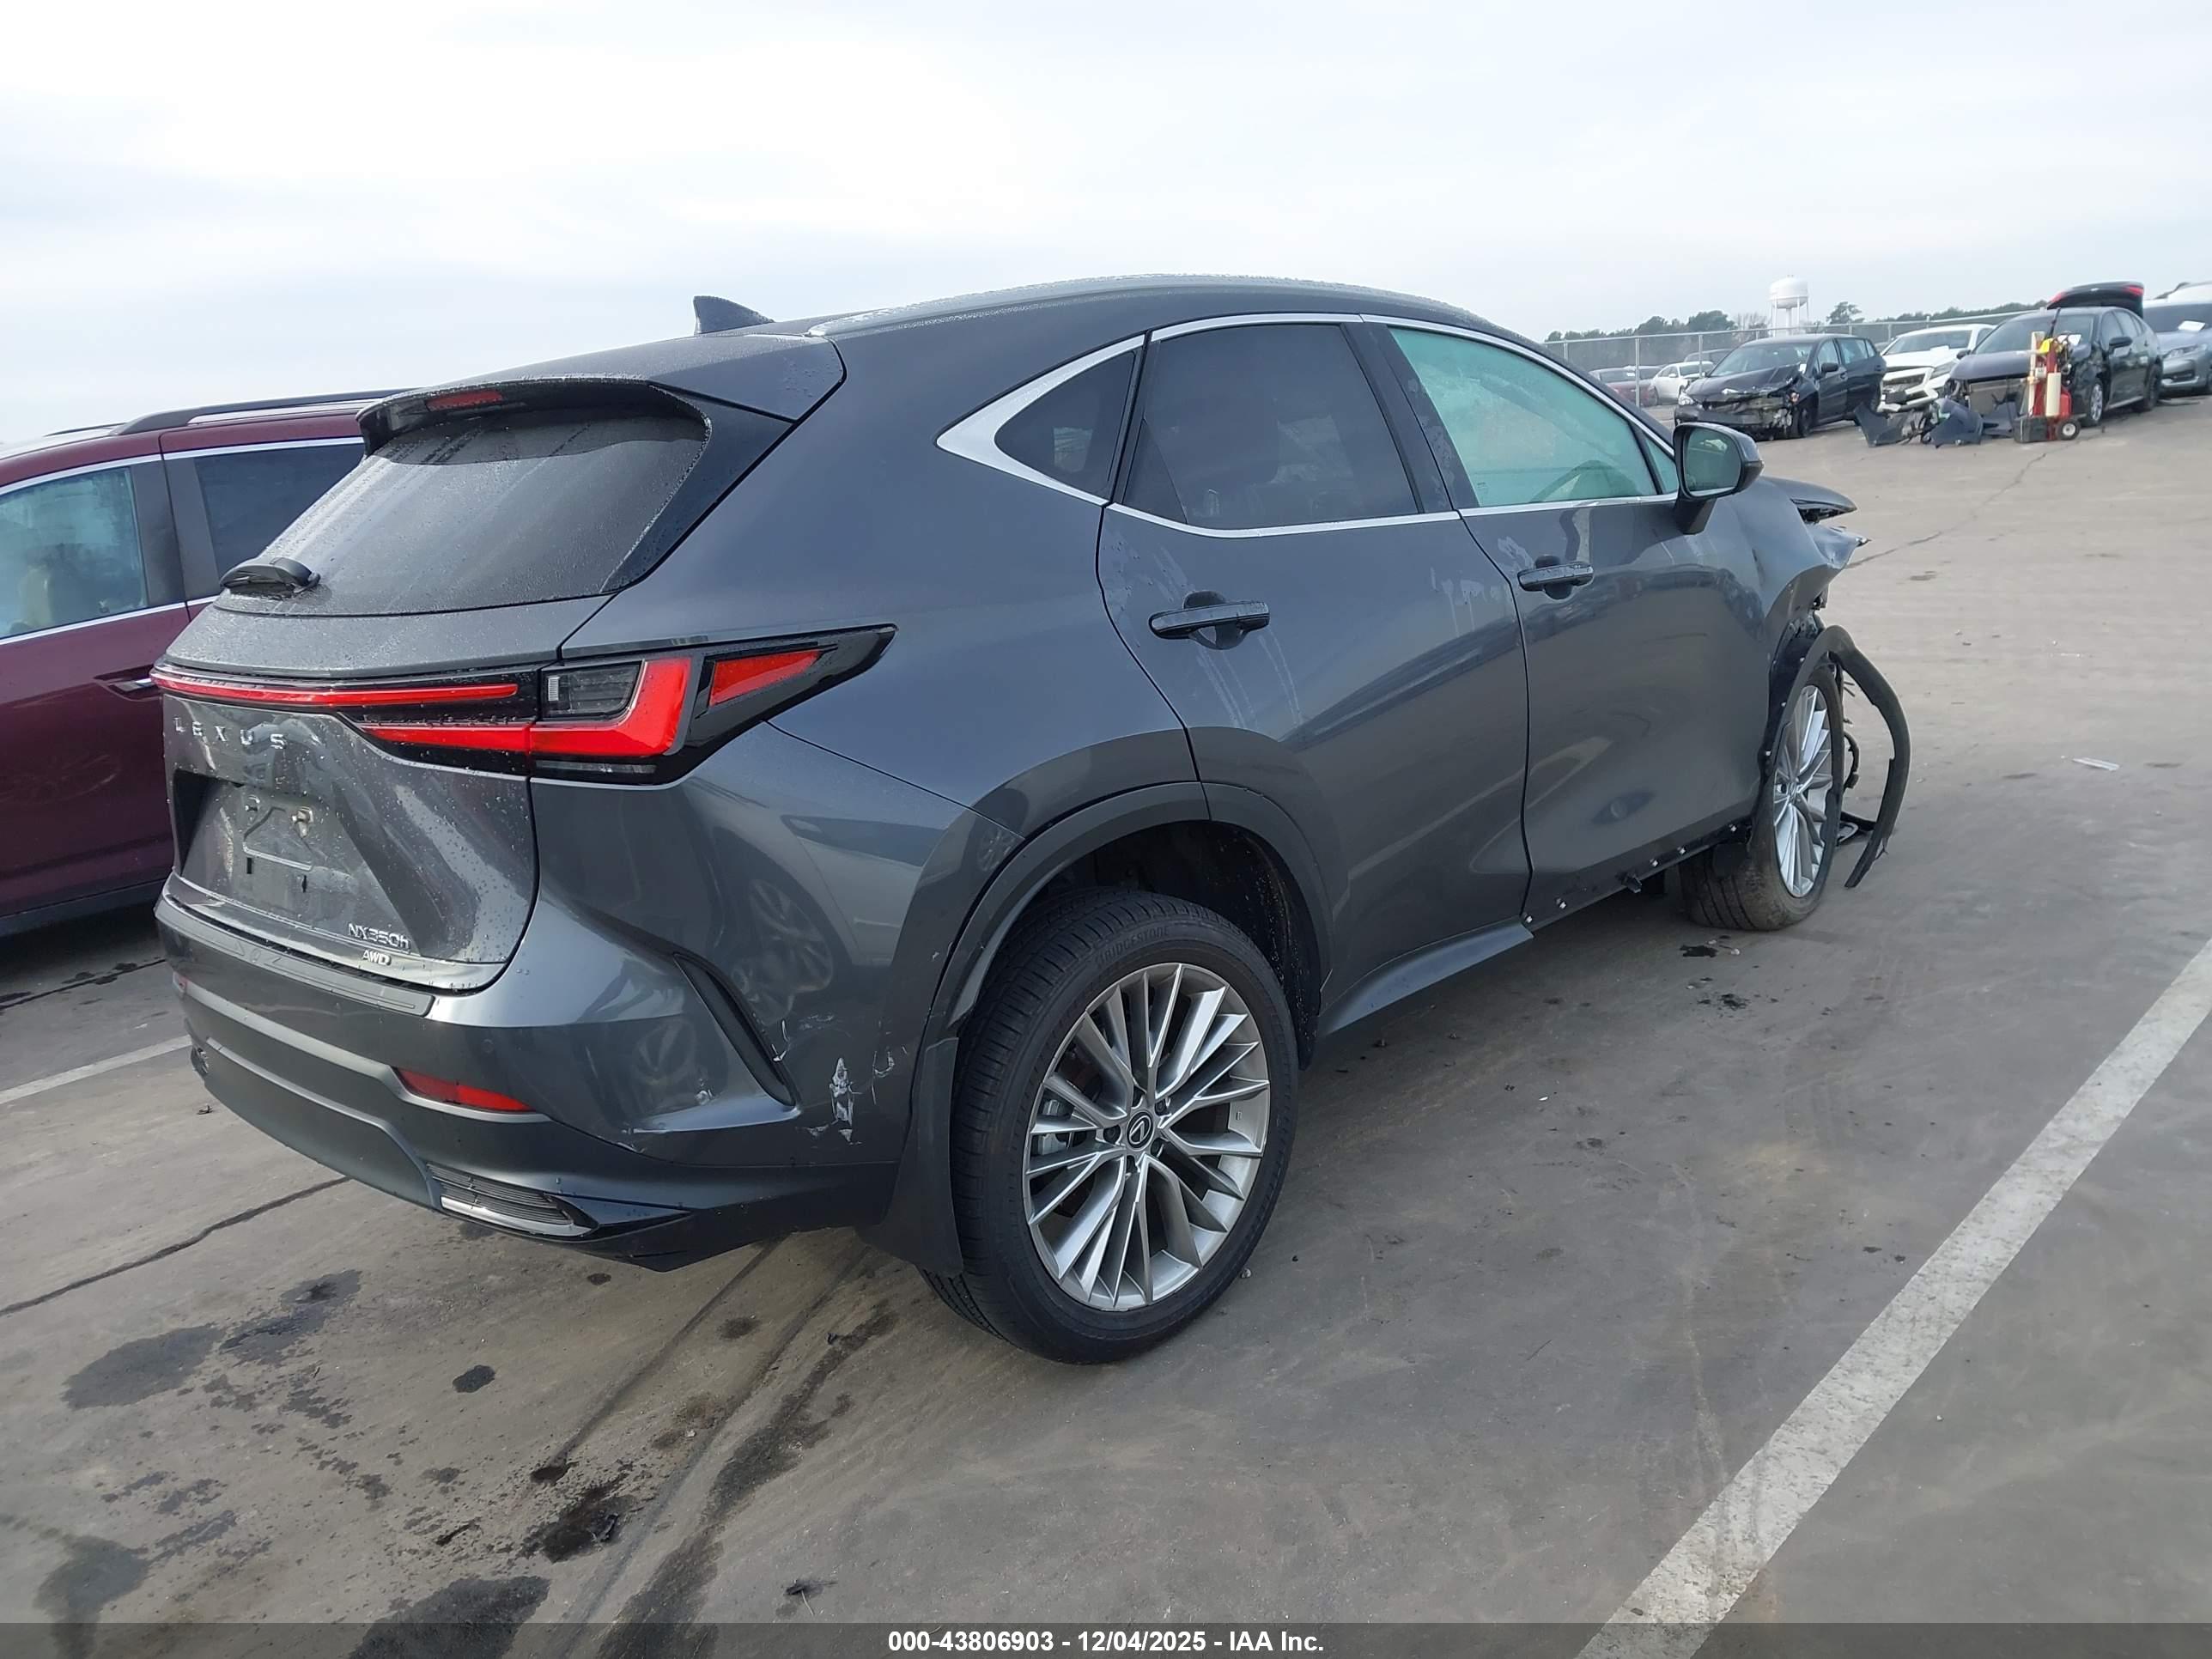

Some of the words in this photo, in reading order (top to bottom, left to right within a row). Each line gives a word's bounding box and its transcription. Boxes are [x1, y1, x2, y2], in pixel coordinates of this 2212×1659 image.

[173, 715, 286, 750] LEXUS
[349, 923, 410, 950] NX350h
[362, 950, 391, 966] AWD
